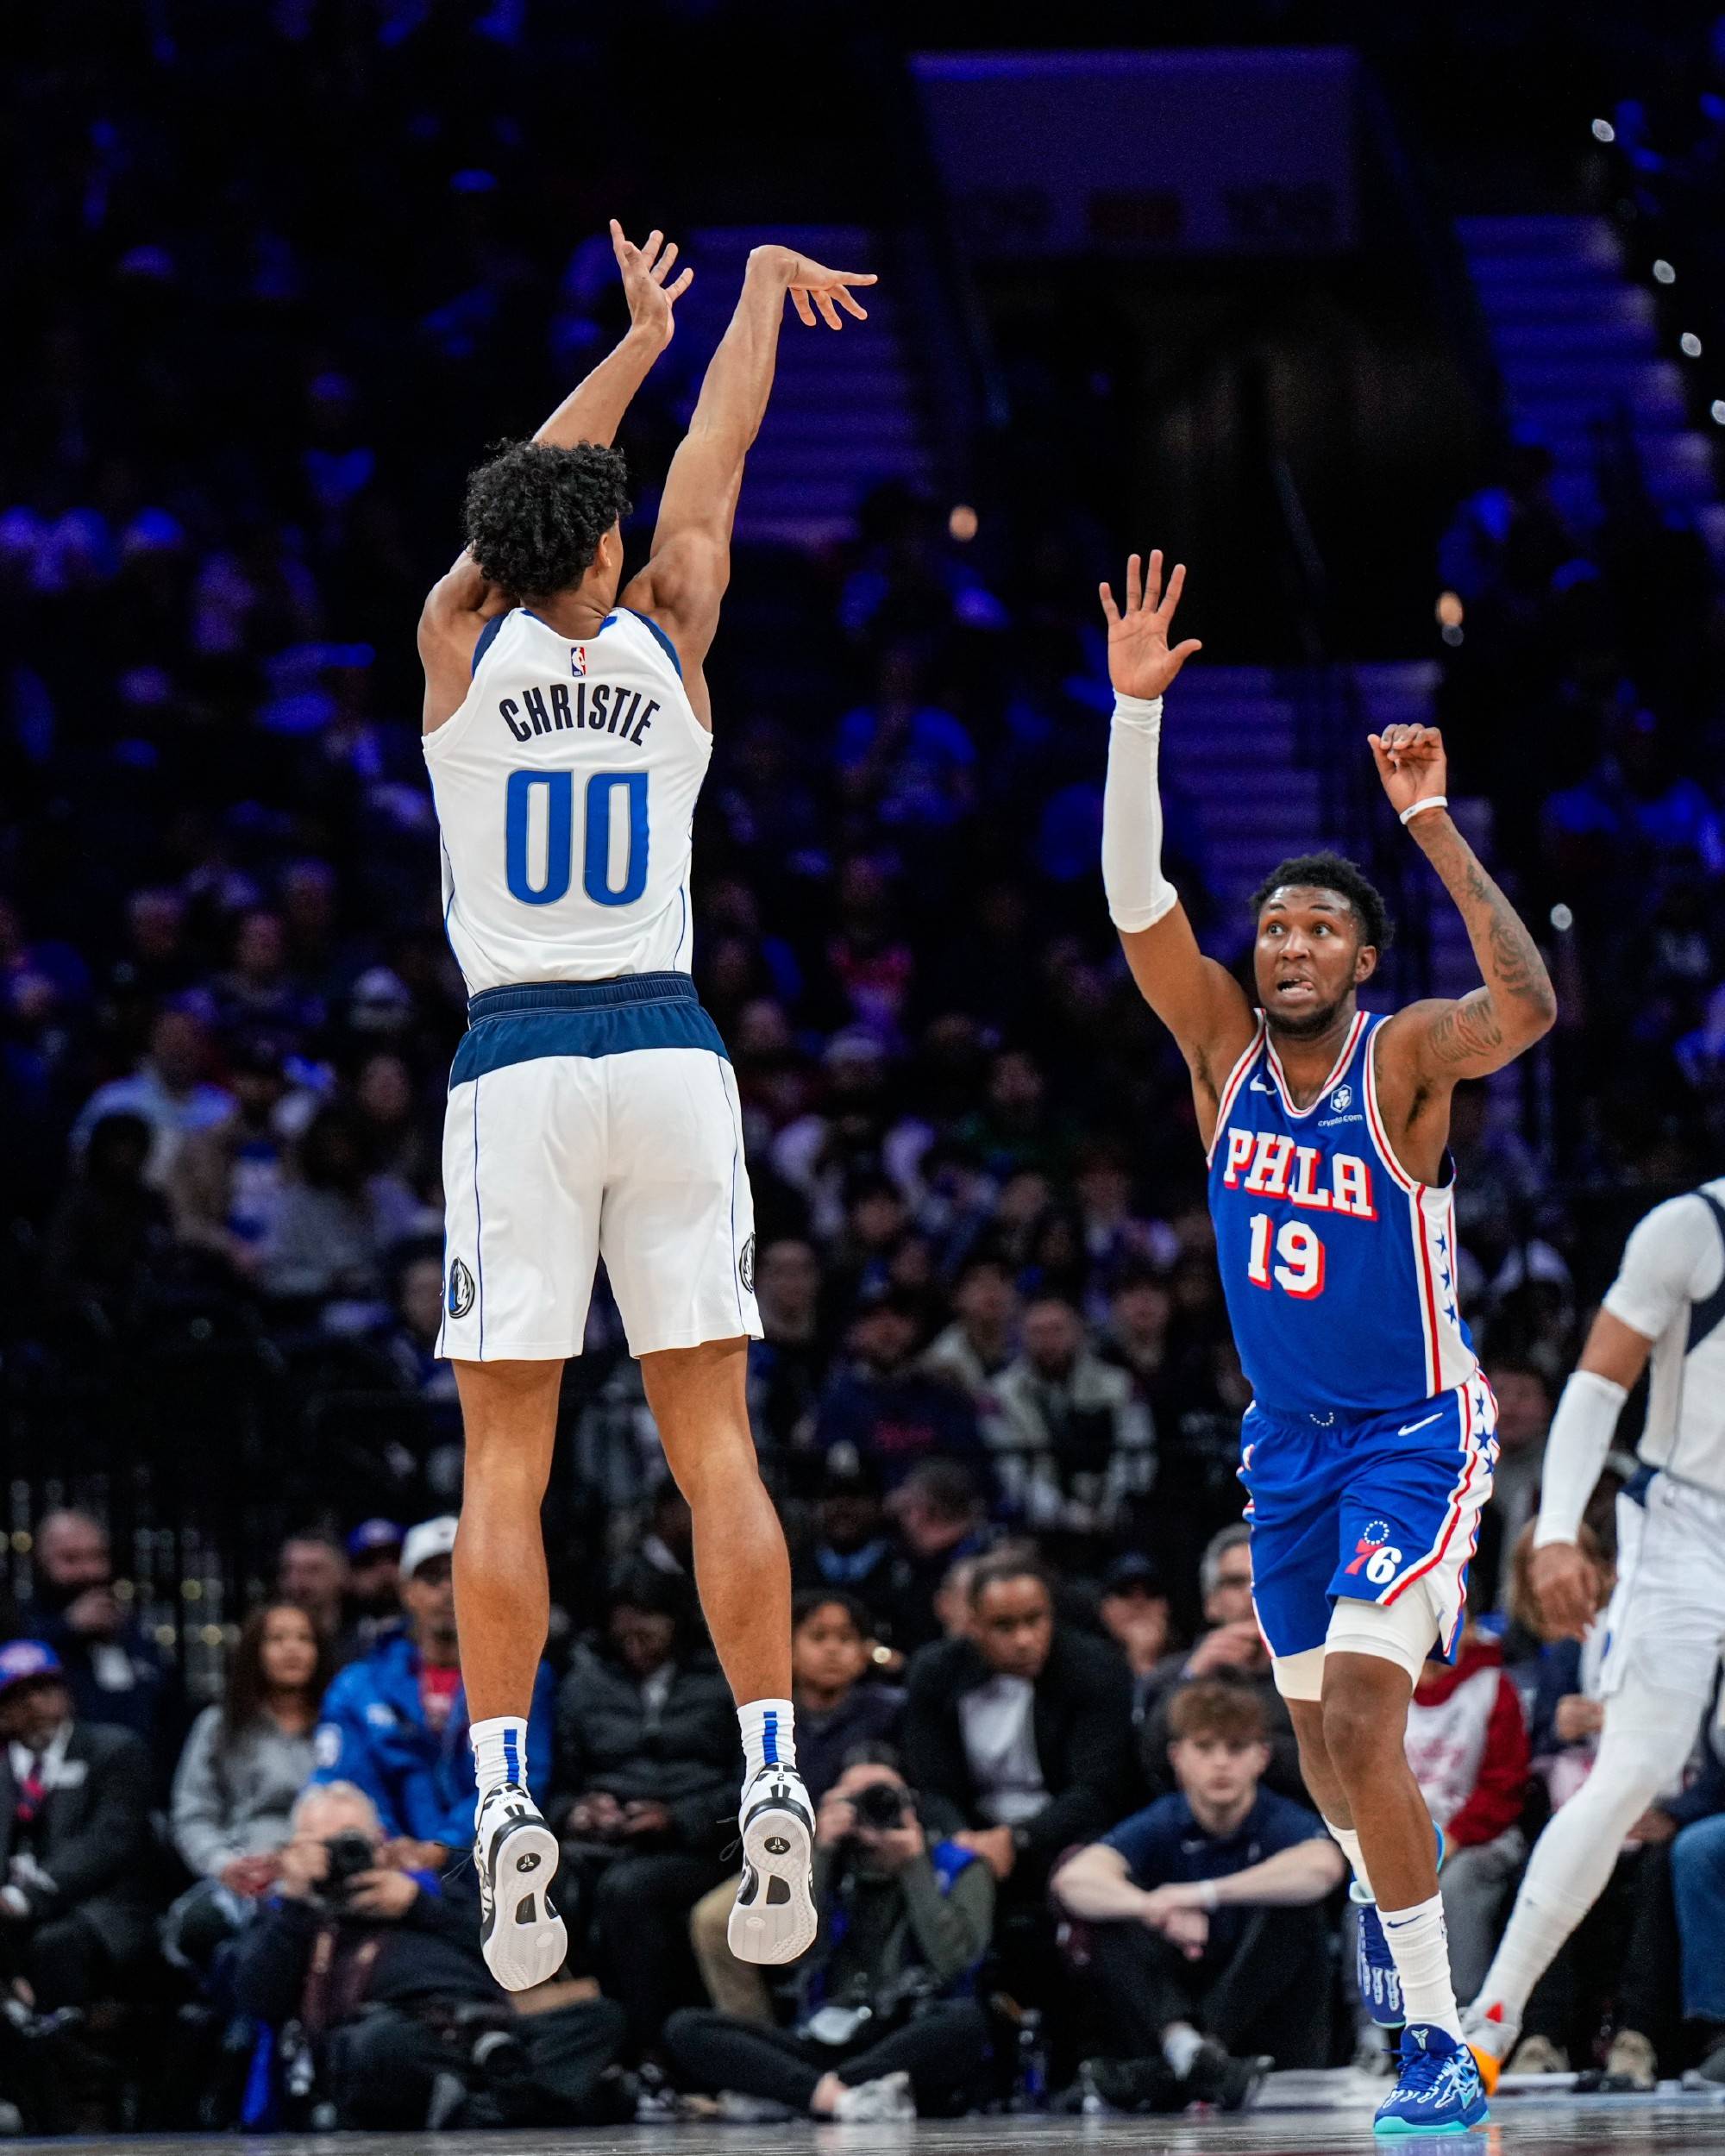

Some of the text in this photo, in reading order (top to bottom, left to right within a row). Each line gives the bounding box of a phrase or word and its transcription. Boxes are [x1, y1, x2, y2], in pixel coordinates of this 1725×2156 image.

[499, 683, 661, 746] CHRISTIE
[505, 768, 649, 907] 00
[1223, 1127, 1378, 1221] PHLA
[1248, 1213, 1326, 1300] 19
[1344, 1539, 1402, 1584] 76
[776, 1772, 785, 1782] 2
